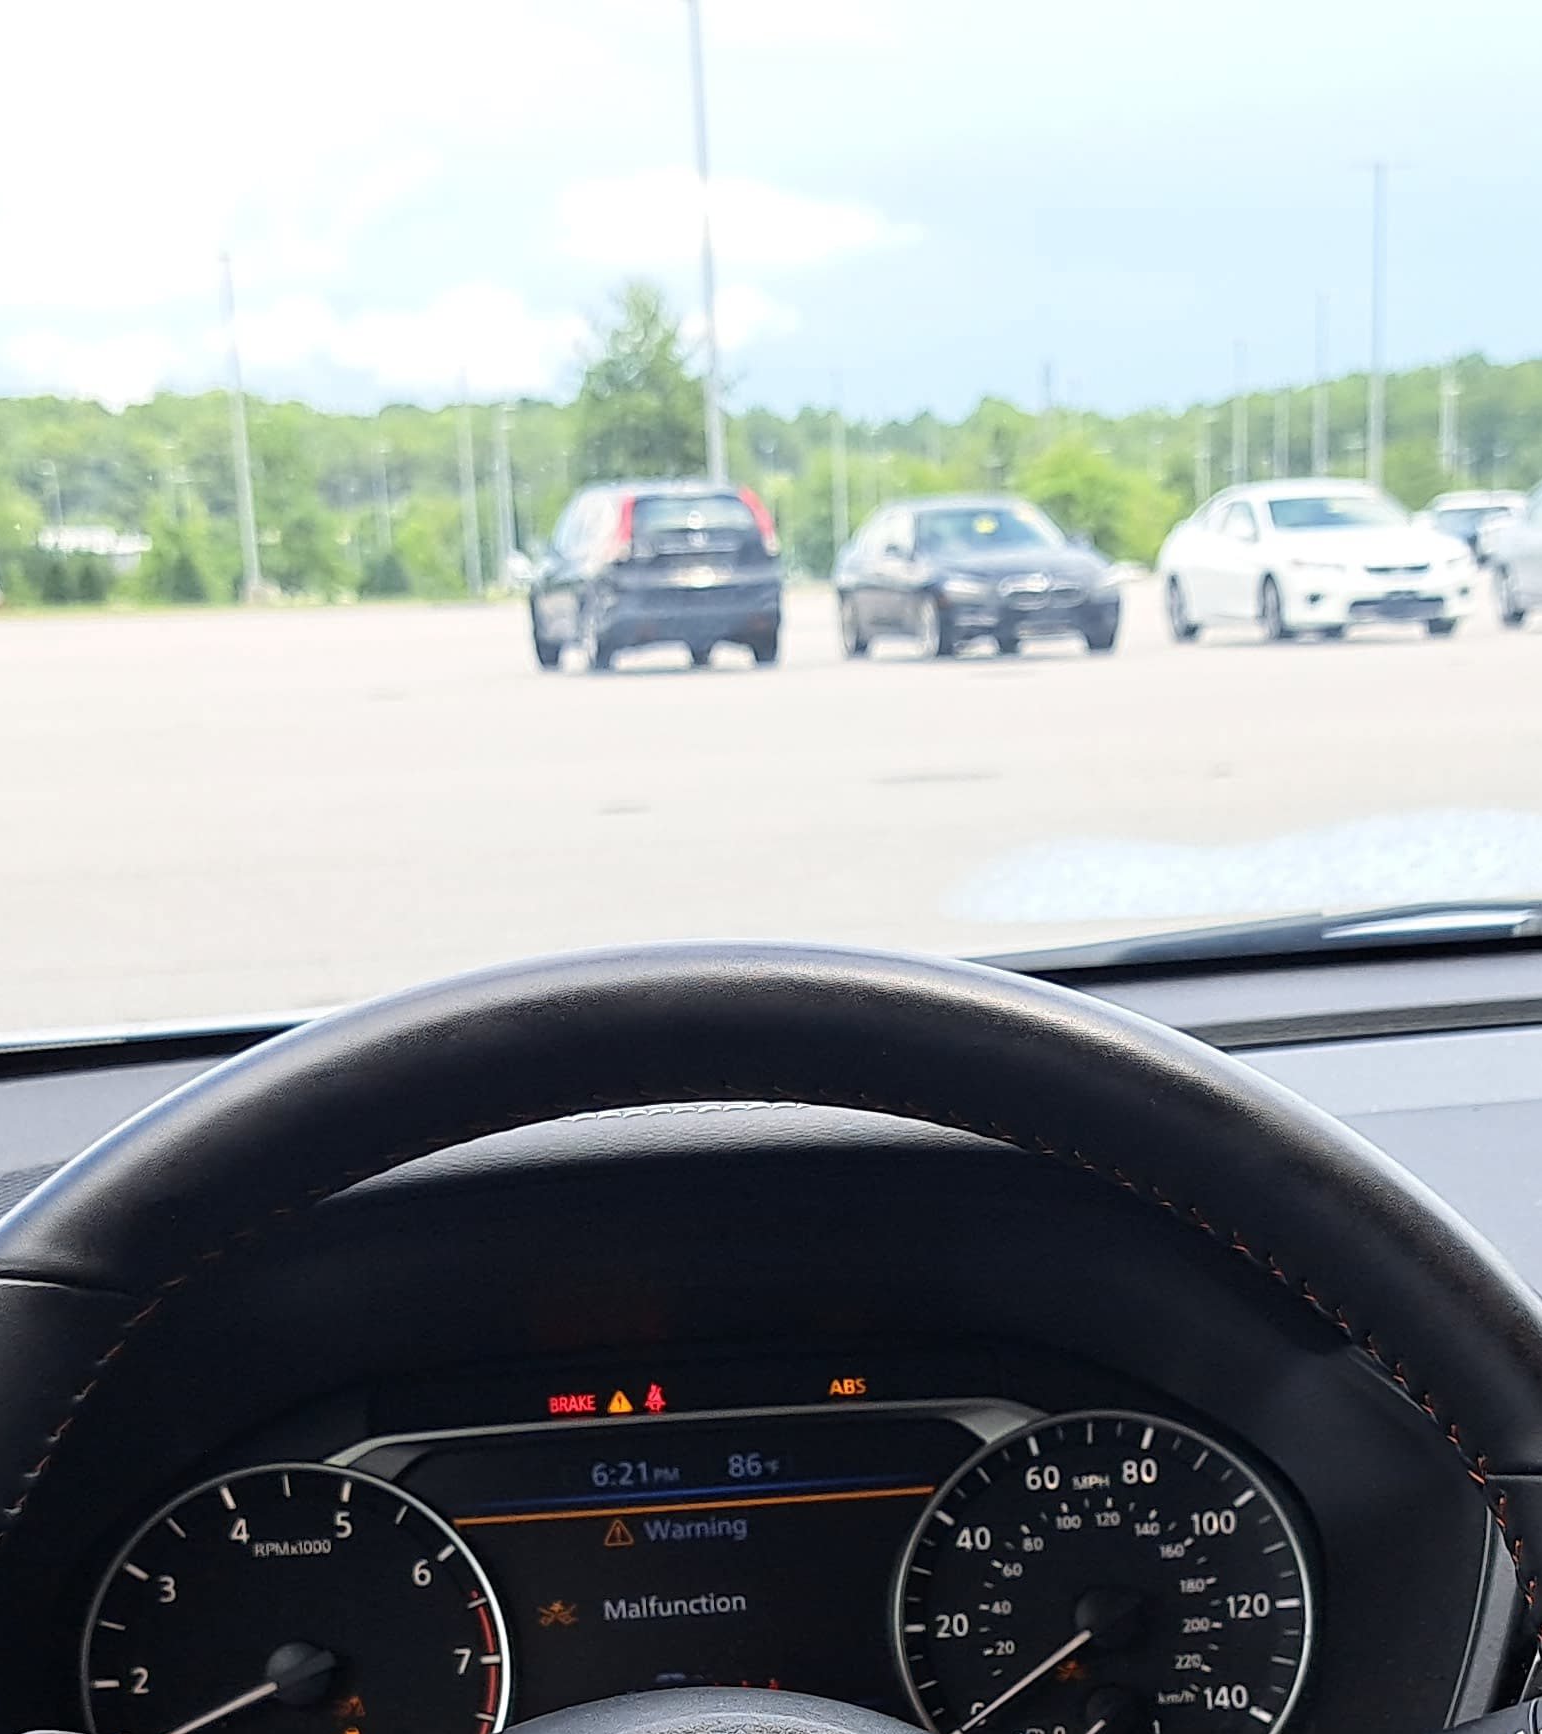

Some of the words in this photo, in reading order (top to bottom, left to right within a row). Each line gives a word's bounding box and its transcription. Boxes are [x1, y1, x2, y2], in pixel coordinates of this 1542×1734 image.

[829, 1378, 867, 1395] ABS
[549, 1395, 596, 1415] BRAKE
[1026, 1465, 1060, 1491] 60
[1072, 1474, 1110, 1490] MPH
[1122, 1458, 1158, 1484] 80
[335, 1511, 354, 1539] 5
[644, 1516, 748, 1543] Warning
[1056, 1515, 1081, 1530] 100
[1095, 1512, 1121, 1527] 120
[1134, 1523, 1160, 1537] 140
[1192, 1511, 1236, 1536] 100
[229, 1518, 250, 1544] 4
[957, 1527, 992, 1551] 40
[1022, 1536, 1044, 1552] 80
[1160, 1543, 1185, 1558] 160
[412, 1559, 432, 1587] 6
[1003, 1563, 1023, 1578] 60
[159, 1575, 178, 1603] 3
[1179, 1579, 1205, 1593] 180
[604, 1592, 747, 1622] Malfunction
[992, 1600, 1012, 1615] 40
[1227, 1594, 1270, 1619] 120
[935, 1613, 970, 1639] 20
[1182, 1617, 1209, 1633] 200
[996, 1641, 1015, 1656] 20
[453, 1648, 472, 1675] 7
[1174, 1654, 1202, 1670] 220
[131, 1667, 150, 1694] 2
[1158, 1690, 1196, 1704] km/h
[1204, 1684, 1249, 1711] 140
